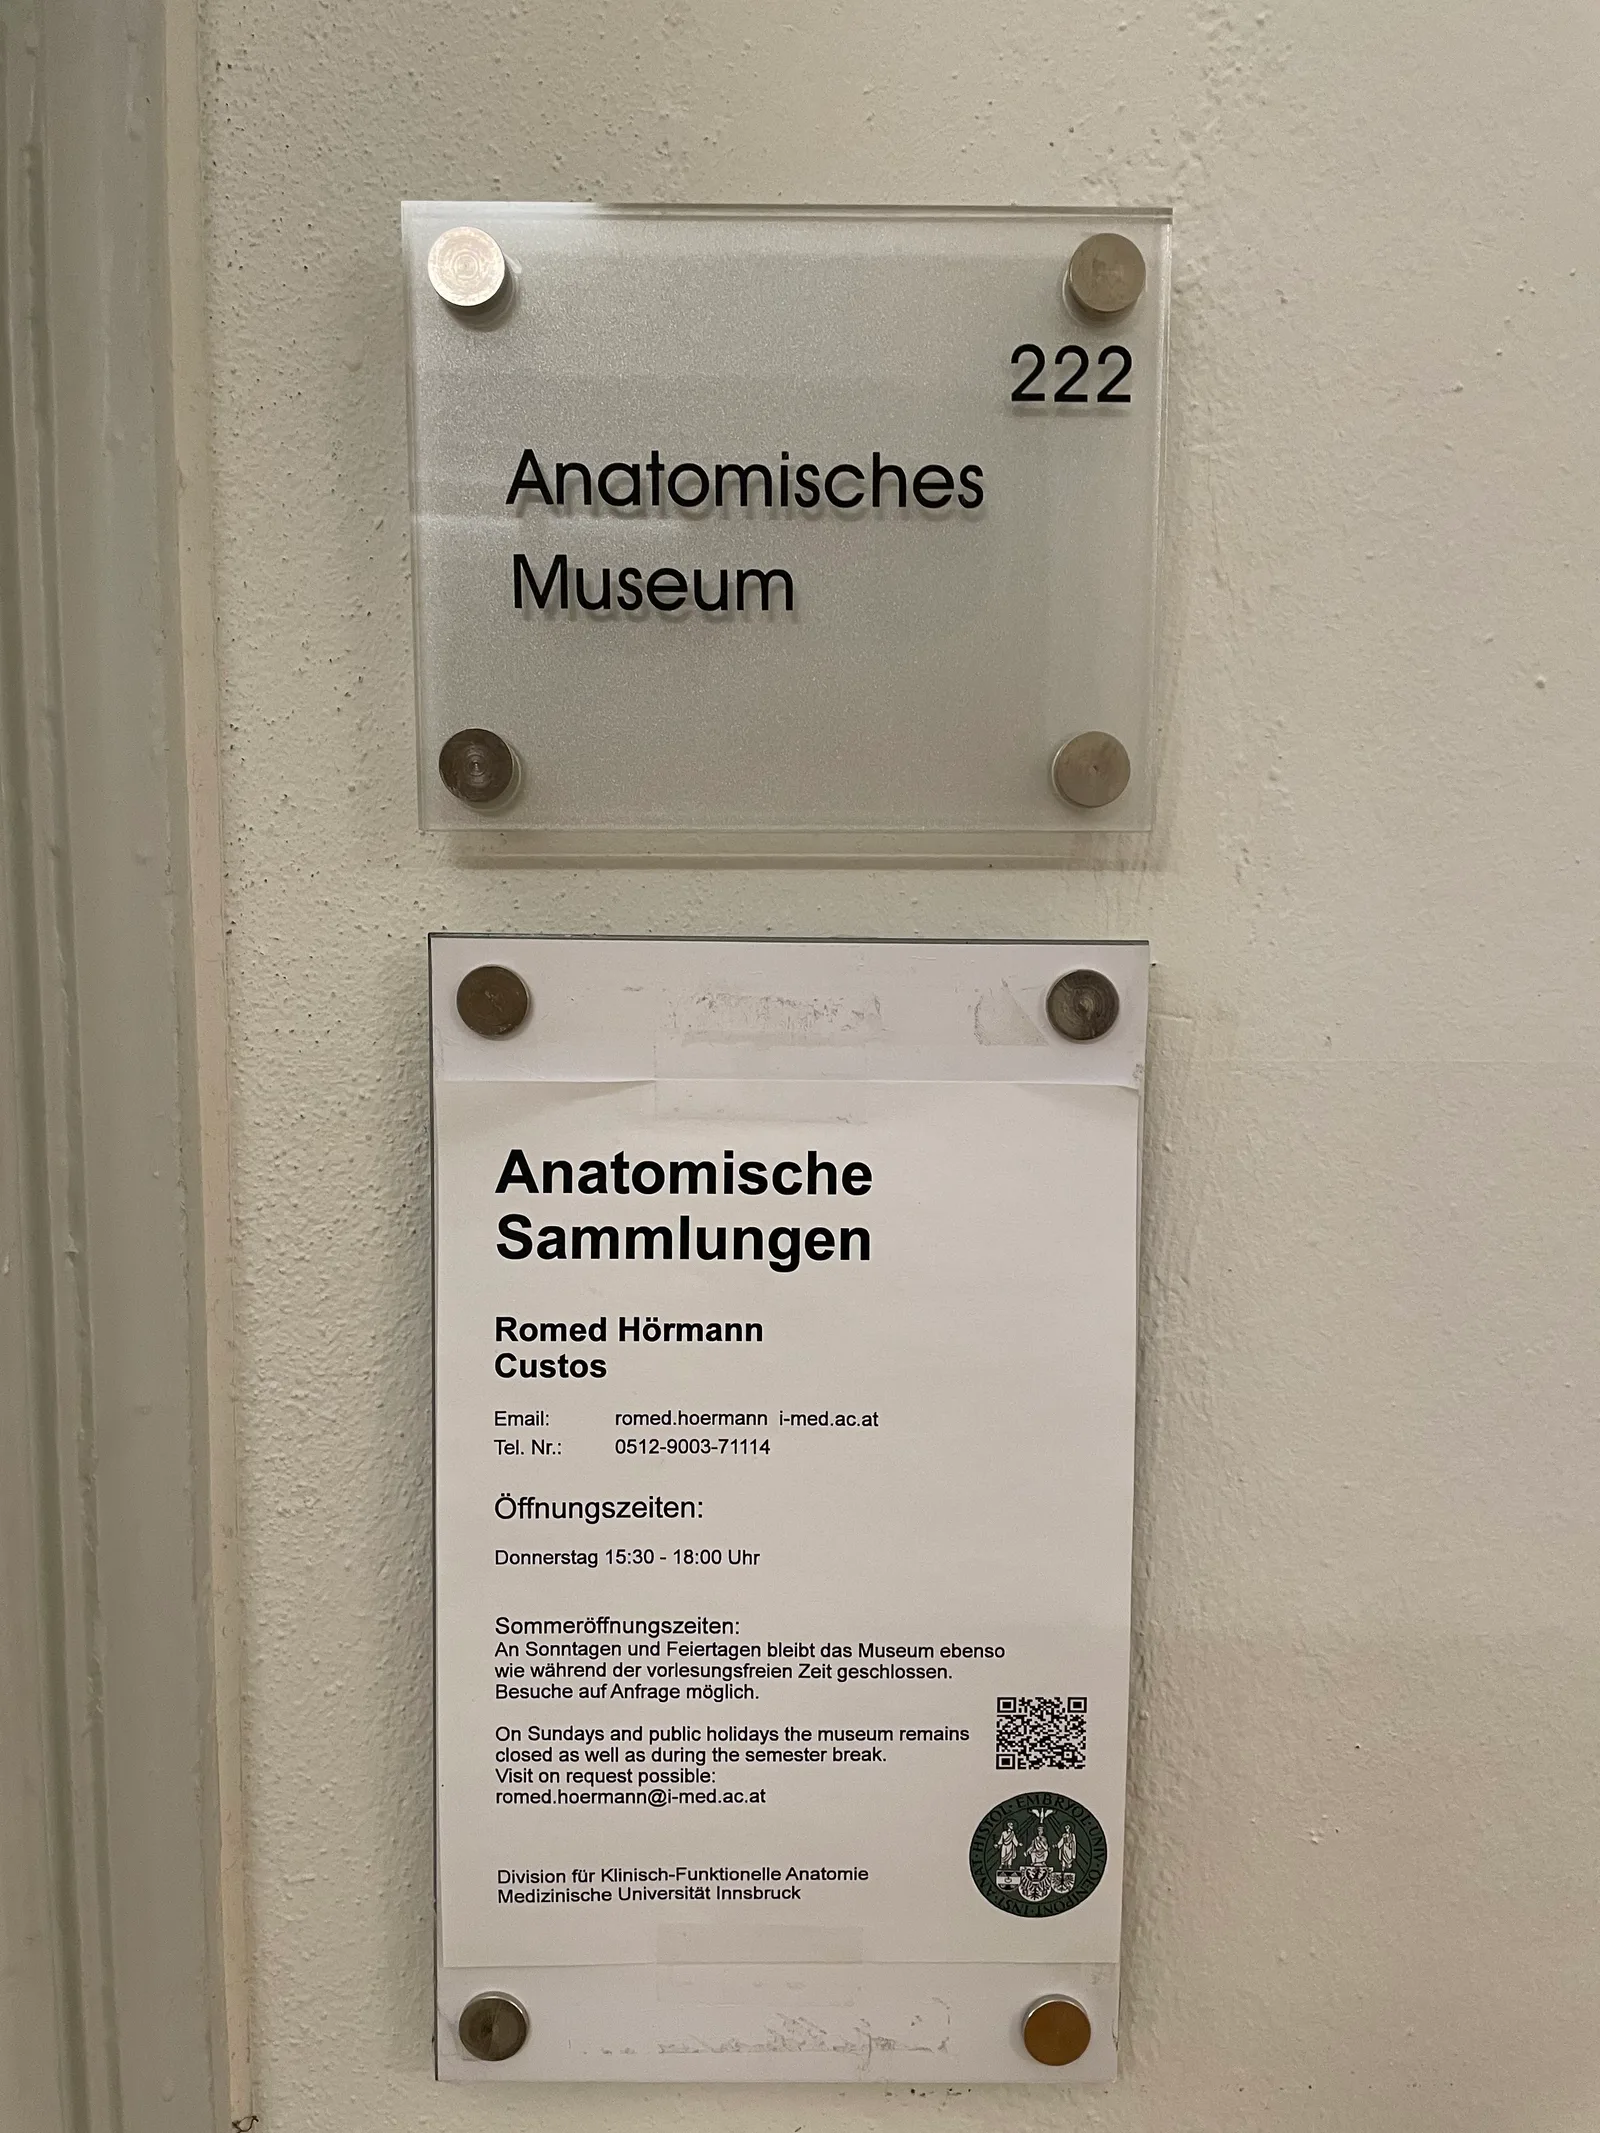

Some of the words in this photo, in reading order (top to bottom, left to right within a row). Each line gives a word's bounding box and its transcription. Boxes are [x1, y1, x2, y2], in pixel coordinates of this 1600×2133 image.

[1011, 343, 1132, 403] 222
[505, 448, 984, 509] Anatomisches
[513, 553, 794, 612] Museum
[494, 1148, 873, 1196] Anatomische
[496, 1213, 870, 1273] Sammlungen
[495, 1316, 607, 1343] Romed
[618, 1316, 763, 1343] Hörmann
[494, 1352, 607, 1379] Custos
[494, 1410, 549, 1427] Email:
[615, 1409, 768, 1426] romed.hoermann
[779, 1410, 879, 1427] i-med.ac.at
[493, 1439, 525, 1456] Tel.
[531, 1438, 562, 1456] Nr.:
[615, 1438, 771, 1455] 0512-9003-71114
[494, 1492, 703, 1525] Öffnungszeiten:
[495, 1549, 598, 1569] Donnerstag
[605, 1548, 655, 1565] 15:30
[673, 1548, 722, 1565] 18:00
[728, 1549, 761, 1566] Uhr
[495, 1615, 740, 1639] Sommeröffnungszeiten:
[494, 1641, 520, 1658] An
[525, 1641, 622, 1660] Sonntagen
[627, 1640, 661, 1657] und
[666, 1640, 761, 1661] Feiertagen
[767, 1641, 816, 1658] bleibt
[820, 1642, 853, 1658] das
[858, 1642, 934, 1659] Museum
[939, 1642, 1006, 1659] ebenso
[494, 1662, 525, 1679] wie
[529, 1661, 607, 1678] während
[612, 1661, 643, 1678] der
[646, 1661, 793, 1682] vorlesungsfreien
[797, 1663, 833, 1679] Zeit
[836, 1663, 953, 1683] geschlossen.
[495, 1682, 574, 1700] Besuche
[578, 1682, 609, 1700] auf
[609, 1683, 681, 1703] Anfrage
[686, 1682, 760, 1703] möglich.
[495, 1726, 522, 1742] On
[527, 1725, 605, 1746] Sundays
[610, 1725, 643, 1742] and
[649, 1725, 702, 1746] public
[706, 1725, 780, 1746] holidays
[783, 1726, 813, 1742] the
[817, 1729, 894, 1742] museum
[899, 1725, 970, 1742] remains
[495, 1746, 553, 1763] closed
[558, 1750, 580, 1763] as
[584, 1746, 619, 1763] well
[624, 1750, 646, 1763] as
[651, 1746, 706, 1767] during
[711, 1746, 740, 1763] the
[744, 1747, 828, 1763] semester
[832, 1746, 887, 1762] break.
[494, 1767, 534, 1784] Visit
[538, 1771, 560, 1784] on
[566, 1768, 633, 1787] request
[638, 1767, 716, 1787] possible:
[496, 1788, 767, 1808] romed.hoermann@i-med.ac.at
[497, 1869, 566, 1885] Division
[571, 1868, 596, 1884] für
[601, 1866, 782, 1883] Klinisch-Funktionelle
[784, 1866, 869, 1881] Anatomie
[497, 1887, 613, 1904] Medizinische
[618, 1885, 711, 1902] Universität
[716, 1885, 802, 1901] Innsbruck
